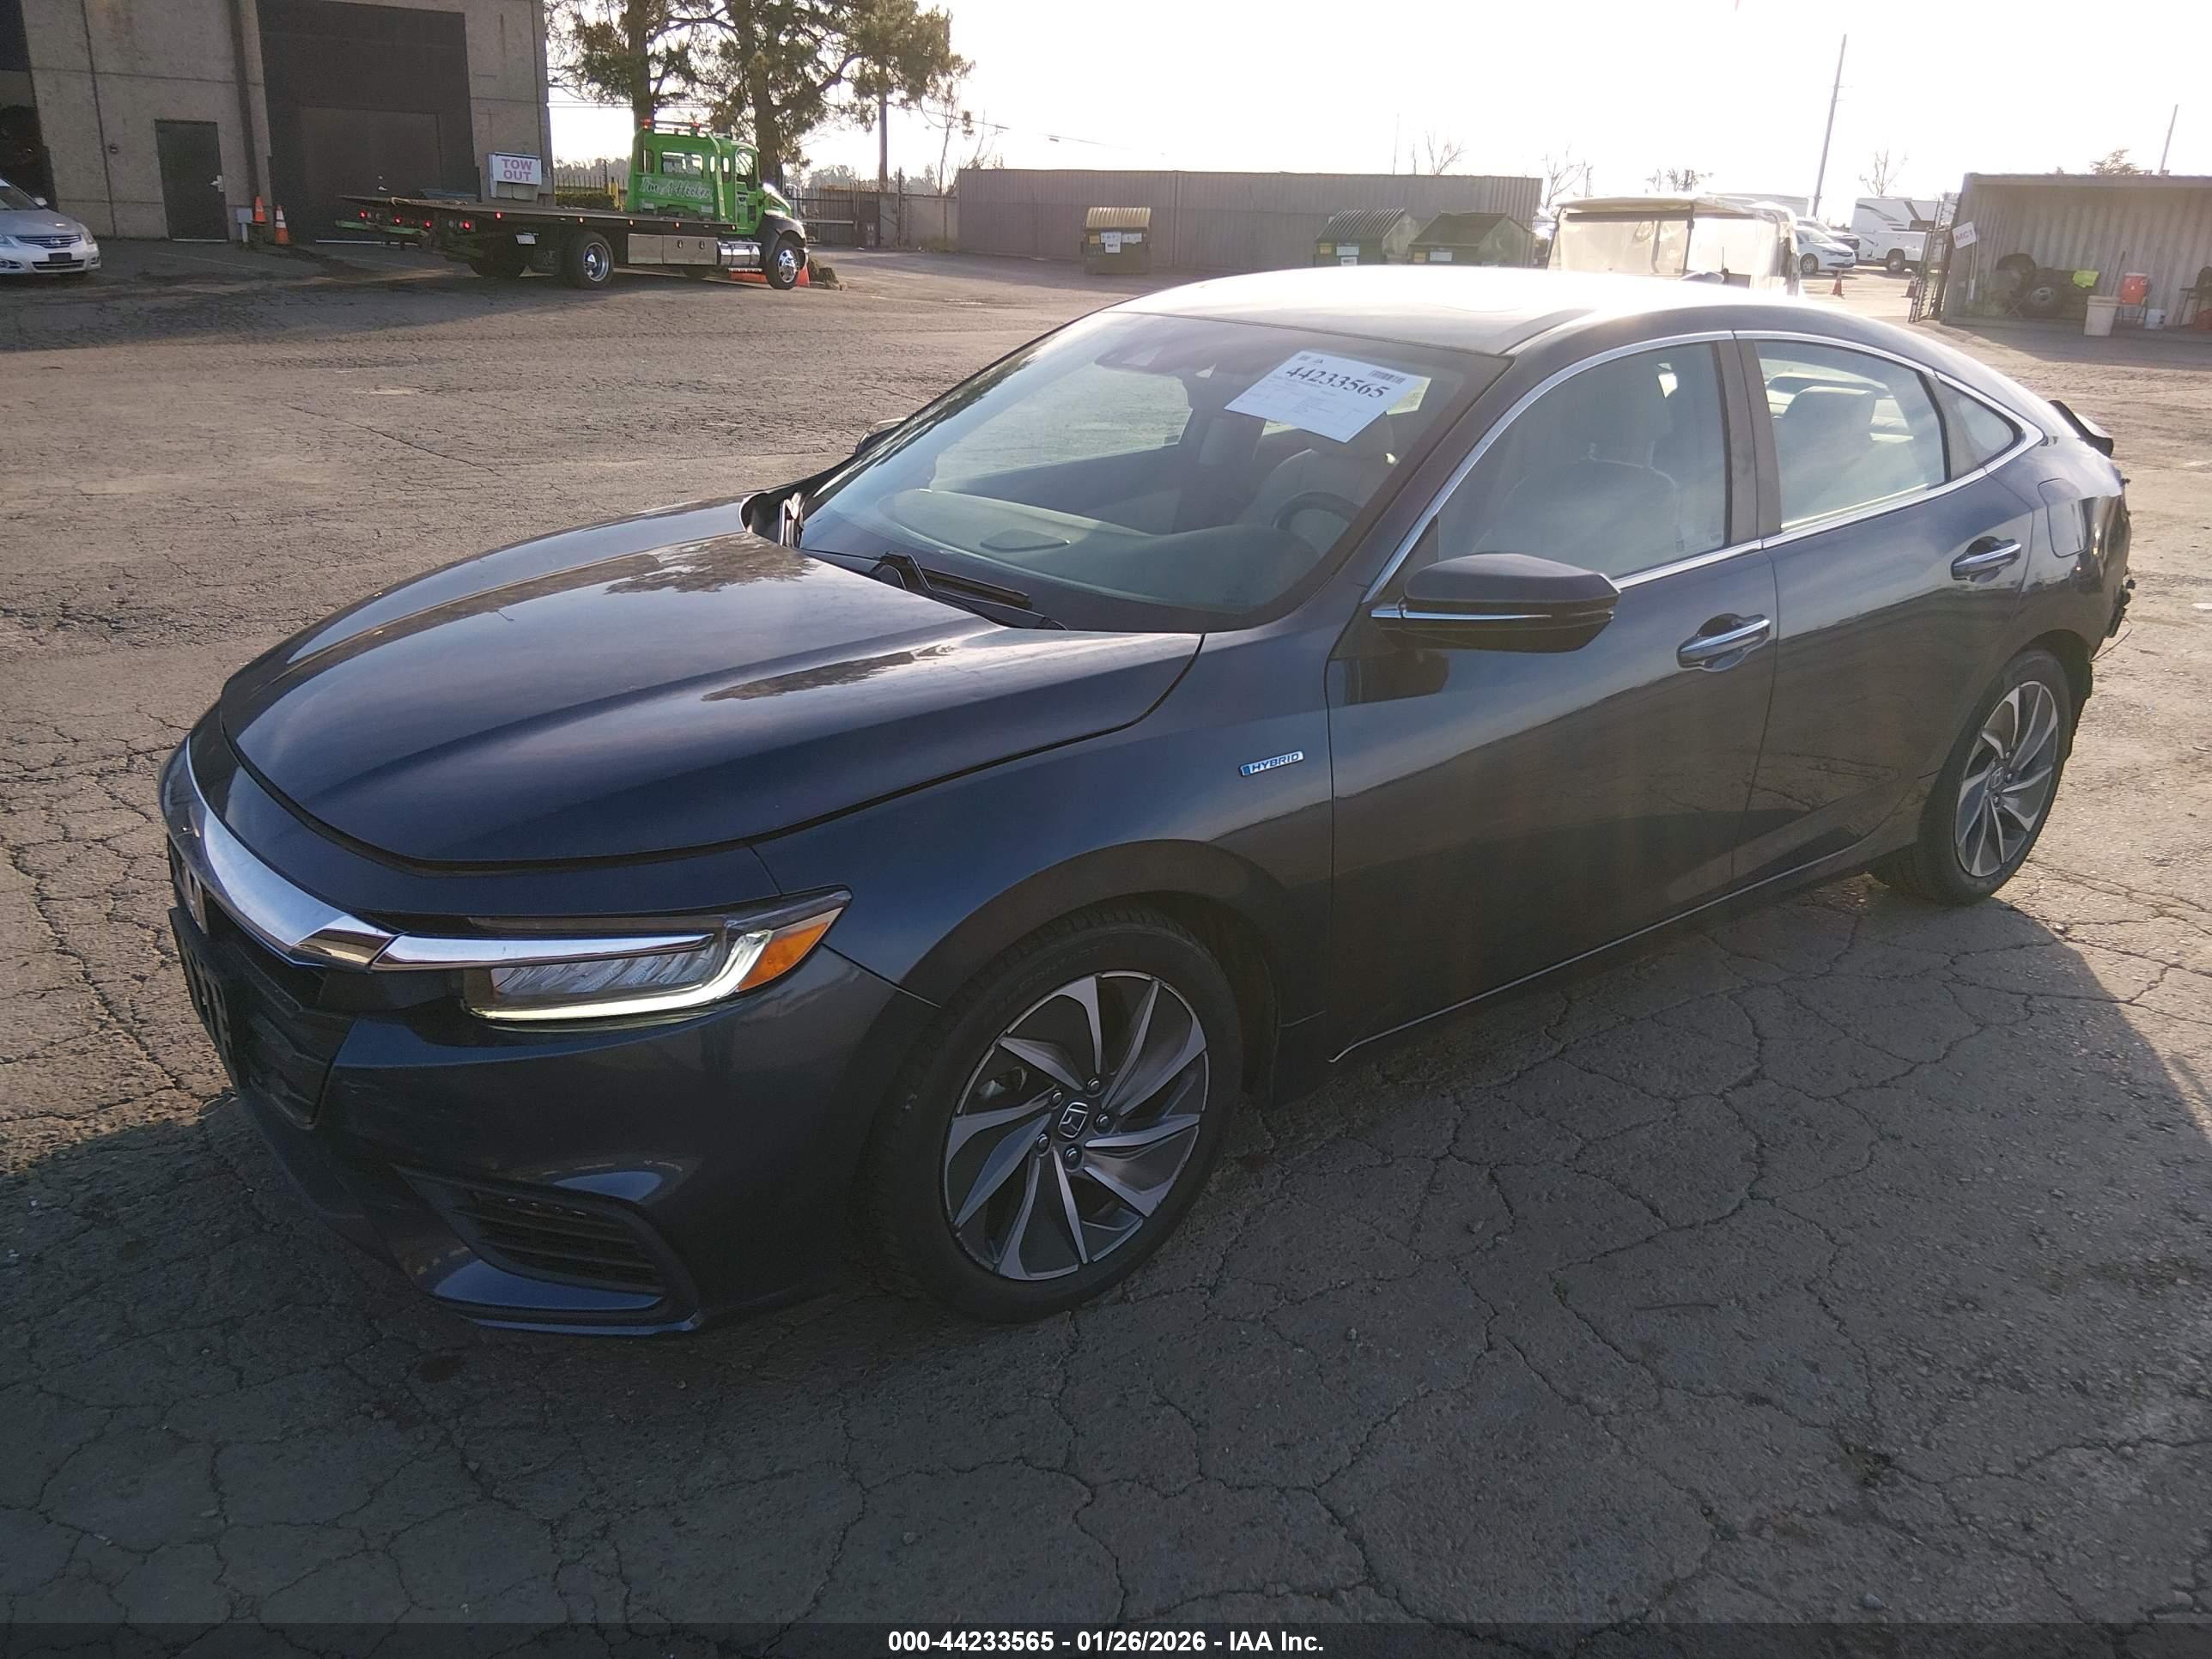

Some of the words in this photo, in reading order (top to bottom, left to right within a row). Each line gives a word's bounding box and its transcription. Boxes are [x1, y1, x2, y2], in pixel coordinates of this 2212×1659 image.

[501, 158, 532, 171] TOW
[503, 170, 532, 181] OUT
[1285, 366, 1389, 398] 44233565
[1252, 753, 1299, 772] HYBRID
